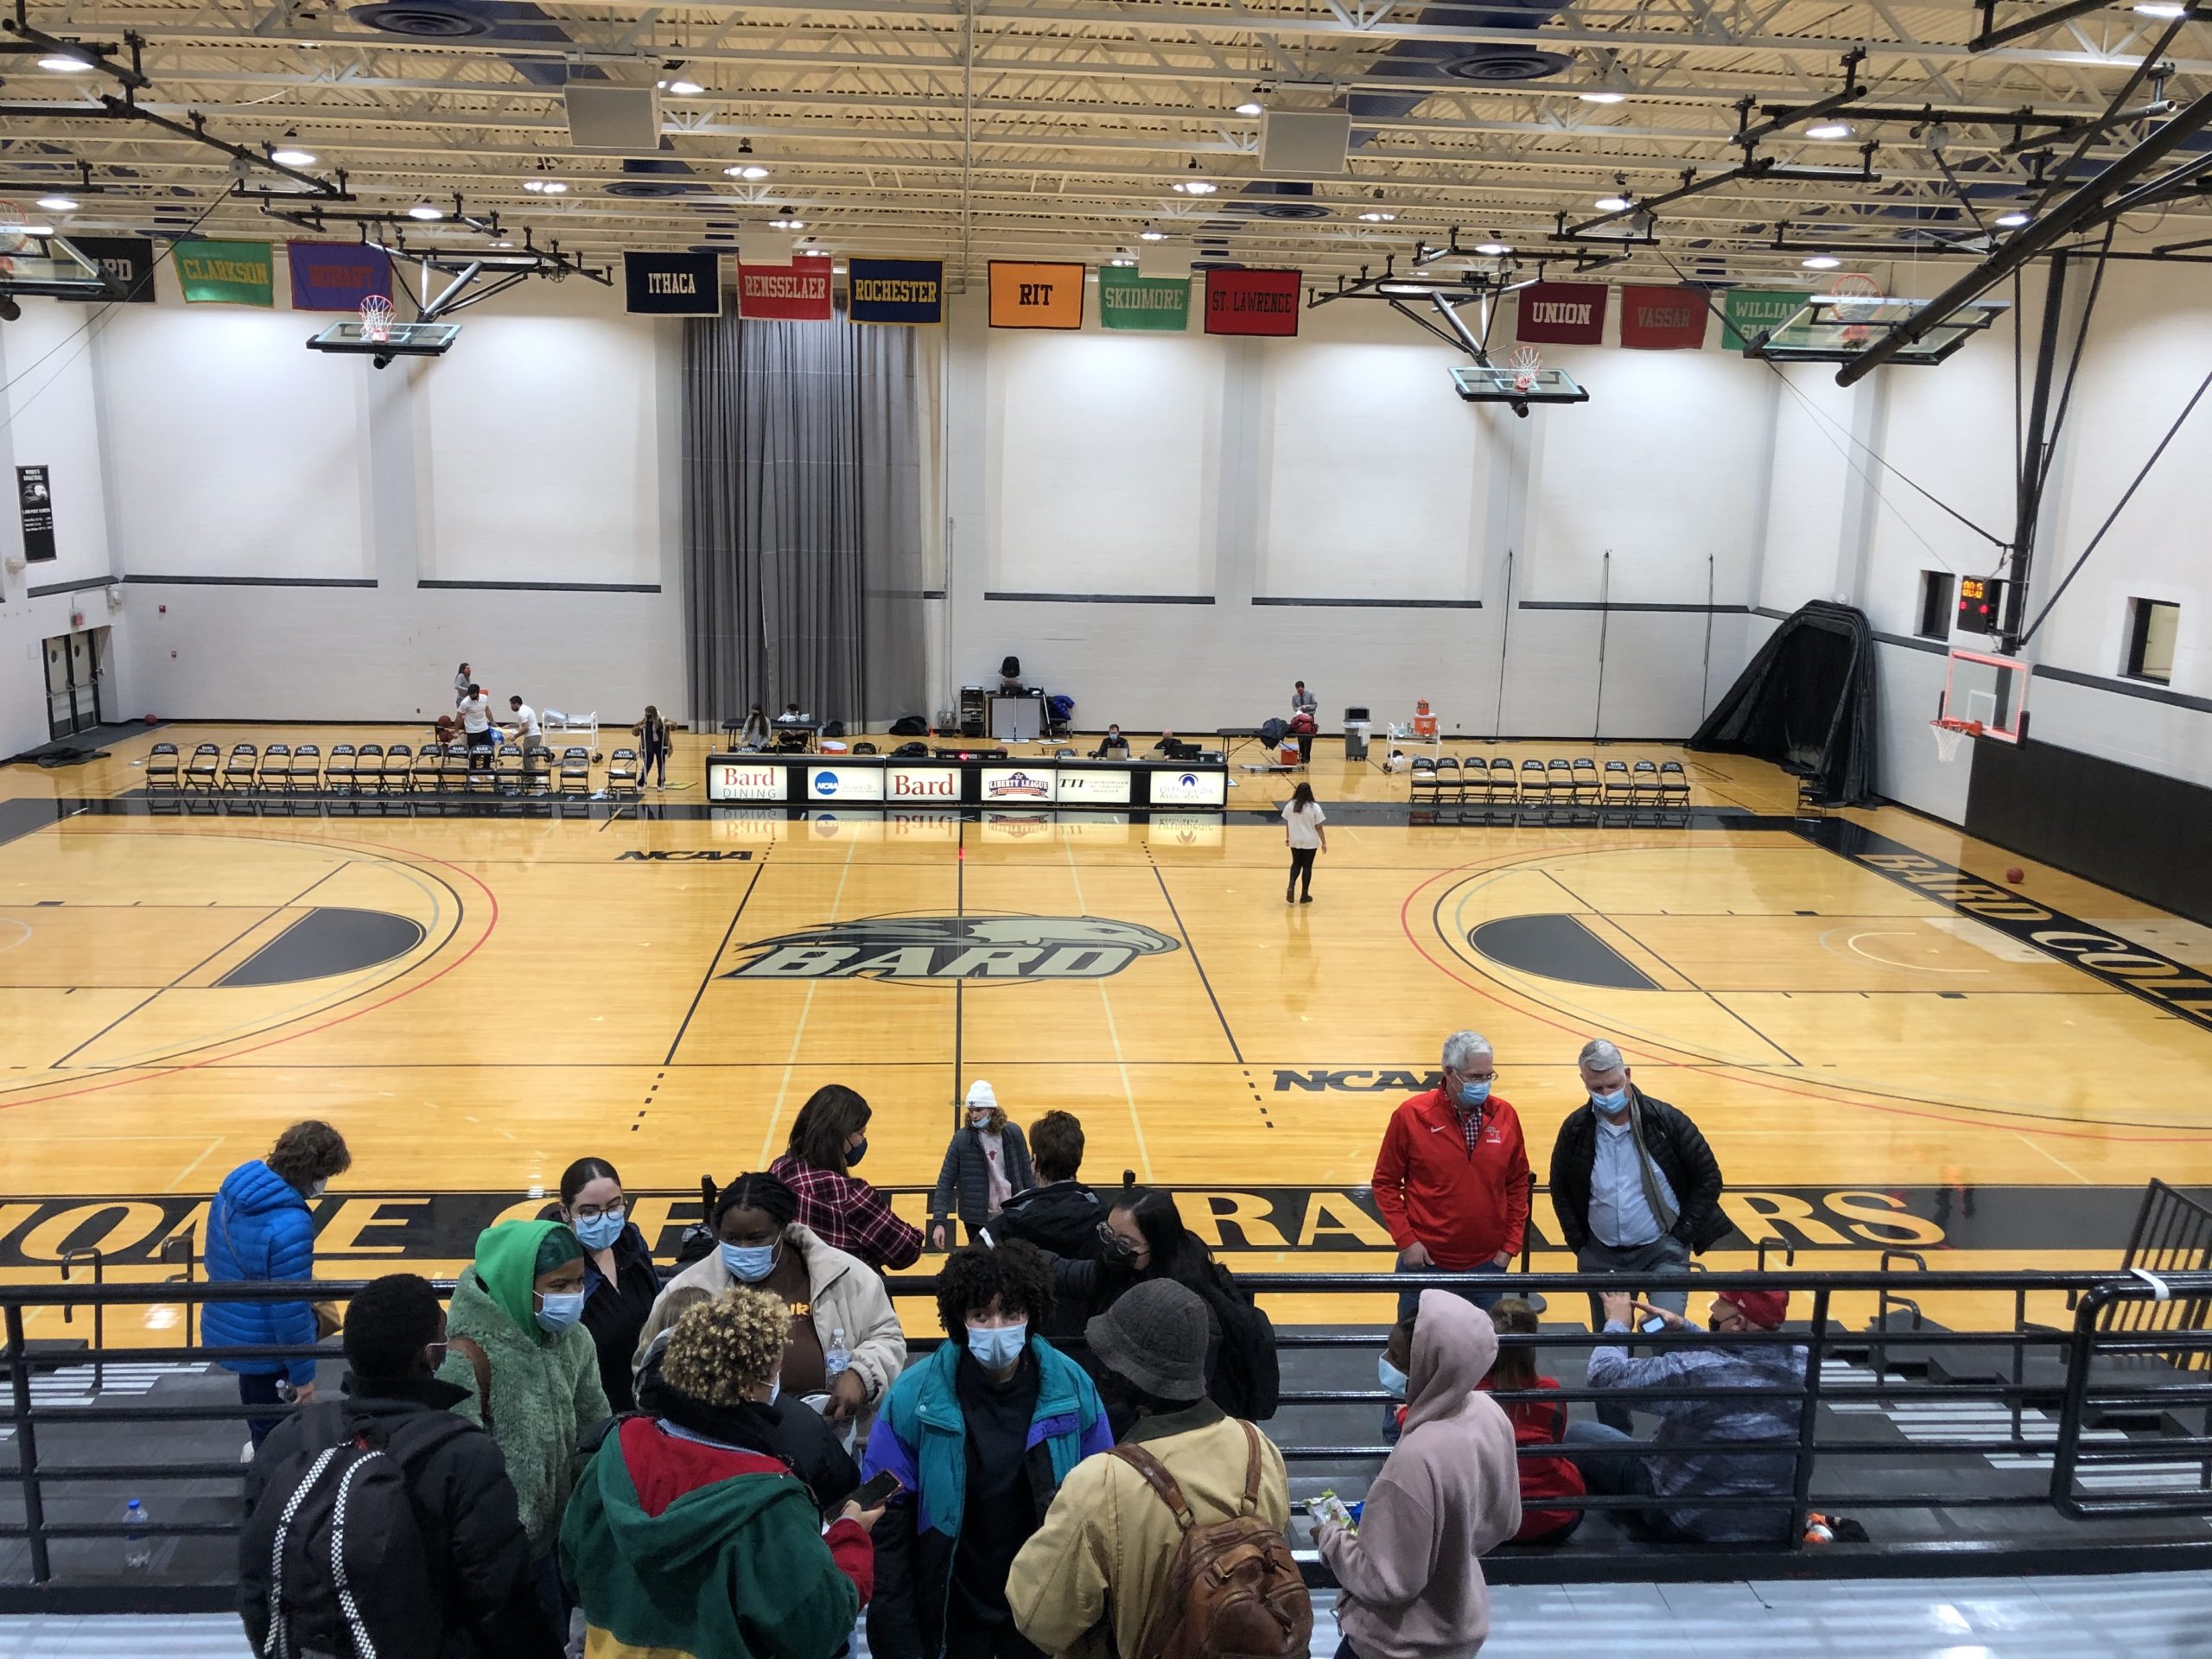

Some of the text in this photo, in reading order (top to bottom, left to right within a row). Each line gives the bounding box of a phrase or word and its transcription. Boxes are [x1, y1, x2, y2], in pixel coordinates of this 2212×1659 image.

[185, 259, 270, 285] CLARKSON
[647, 272, 696, 295] ITHACA
[744, 275, 825, 299] RENSSELAER
[855, 278, 937, 303] ROCHESTER
[1019, 283, 1053, 306] RIT
[1104, 287, 1184, 310] SKIDMORE
[1212, 290, 1292, 314] ST. LAWRENCE
[1532, 302, 1592, 326] UNION
[1637, 307, 1691, 327] VASSAR
[724, 767, 775, 786] Bard
[893, 773, 955, 796] Bard
[989, 779, 1048, 790] LIBERTY LEAGUE
[1059, 779, 1084, 788] TTI
[723, 787, 776, 798] DINING
[613, 851, 753, 861] NCAA
[1853, 854, 2053, 921] BARD
[744, 945, 1131, 976] BARD
